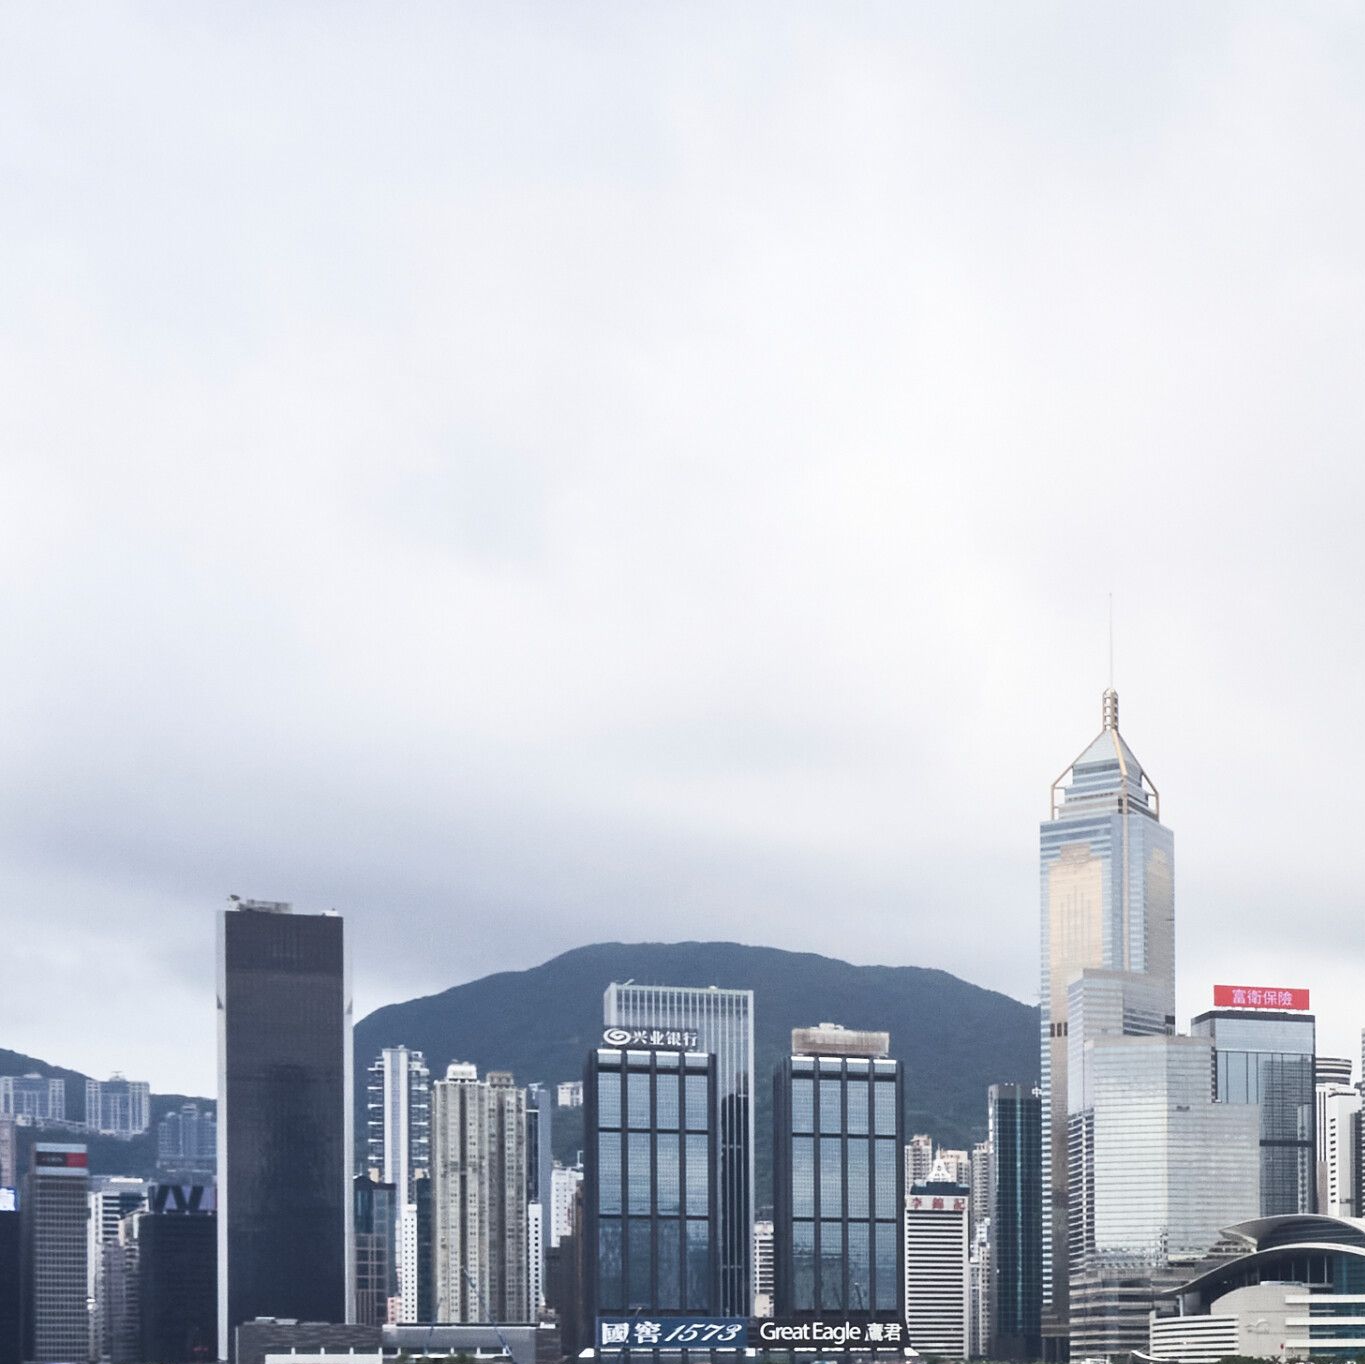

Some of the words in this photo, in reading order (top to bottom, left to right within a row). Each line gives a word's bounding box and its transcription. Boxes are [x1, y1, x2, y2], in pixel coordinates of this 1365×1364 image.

[1232, 988, 1293, 1006] 富衛保險
[631, 1029, 699, 1047] 兴业银行
[760, 1322, 811, 1340] Great
[812, 1321, 862, 1345] Eagle
